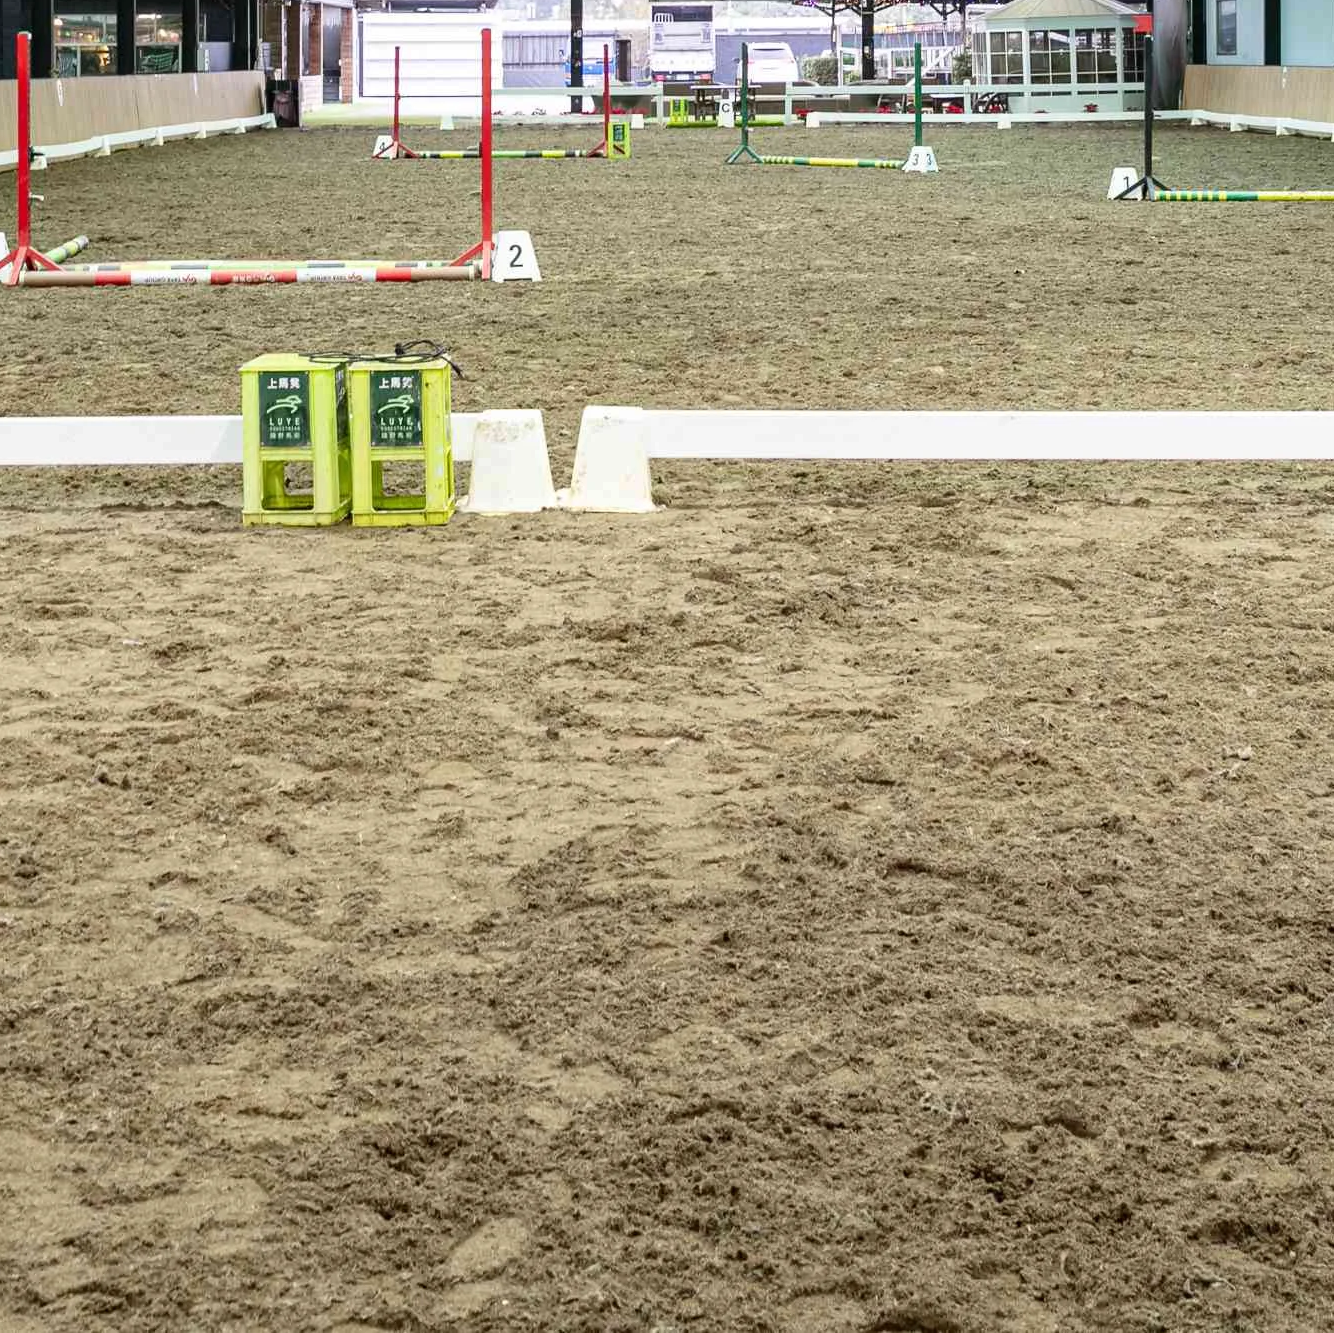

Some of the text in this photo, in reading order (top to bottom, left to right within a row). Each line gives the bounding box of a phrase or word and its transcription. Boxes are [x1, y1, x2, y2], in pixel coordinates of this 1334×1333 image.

[721, 102, 731, 113] C
[912, 154, 919, 166] 3
[926, 154, 933, 166] 3
[1123, 176, 1130, 191] 1
[509, 244, 524, 268] 2
[270, 418, 300, 426] LUYE
